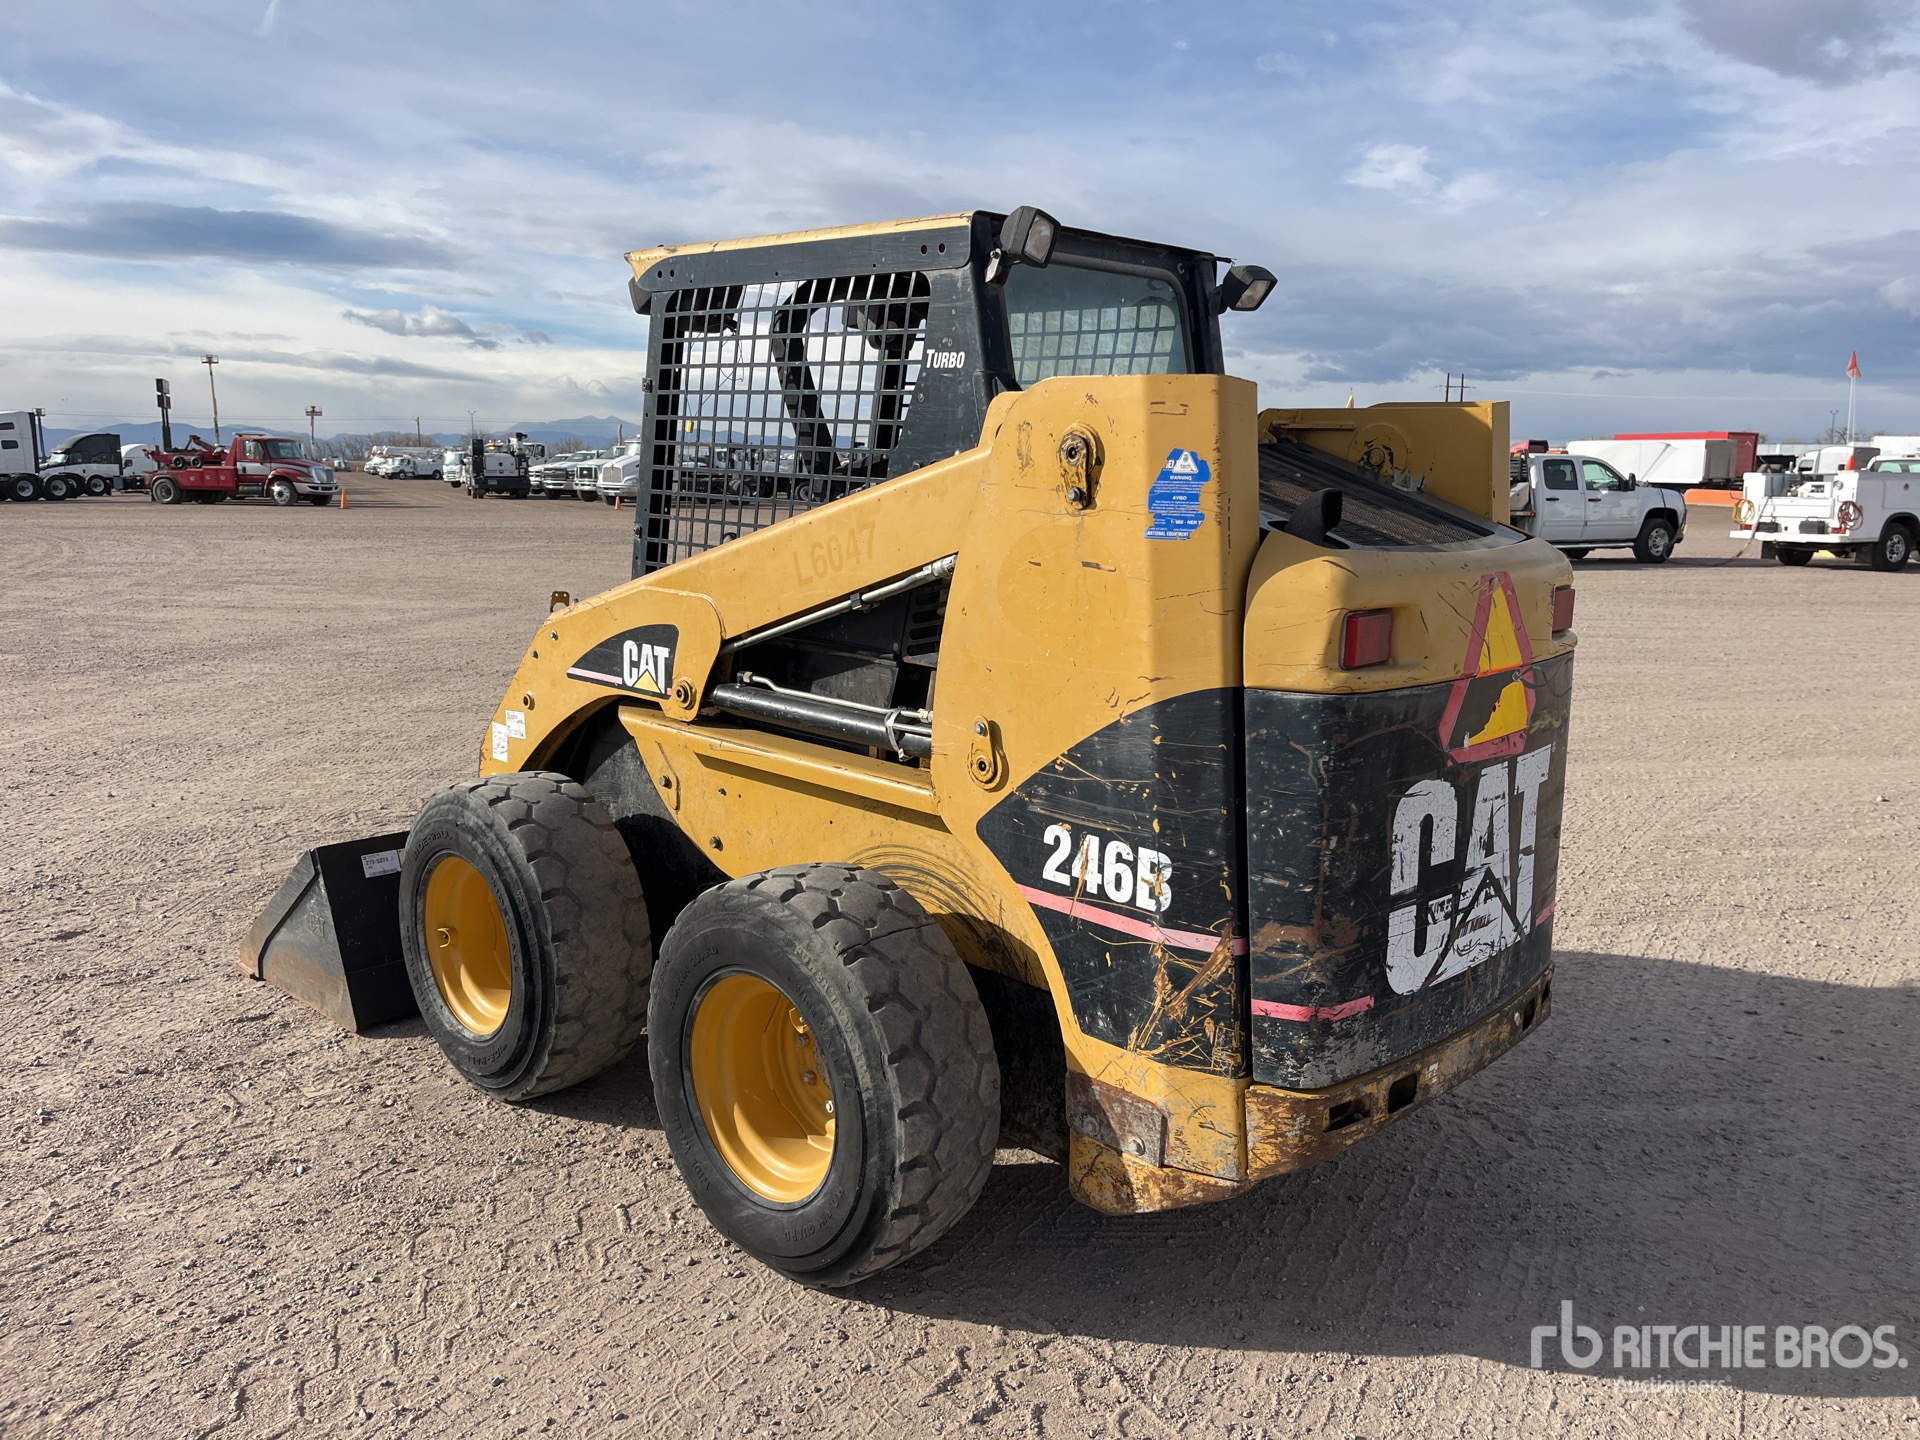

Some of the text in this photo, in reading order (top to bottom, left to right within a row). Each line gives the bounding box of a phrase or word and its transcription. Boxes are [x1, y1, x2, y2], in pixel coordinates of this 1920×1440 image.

[926, 349, 965, 369] TURBO
[792, 520, 876, 587] L6047
[622, 639, 669, 694] CAT
[1042, 823, 1173, 913] 246B
[1385, 744, 1553, 996] CAT
